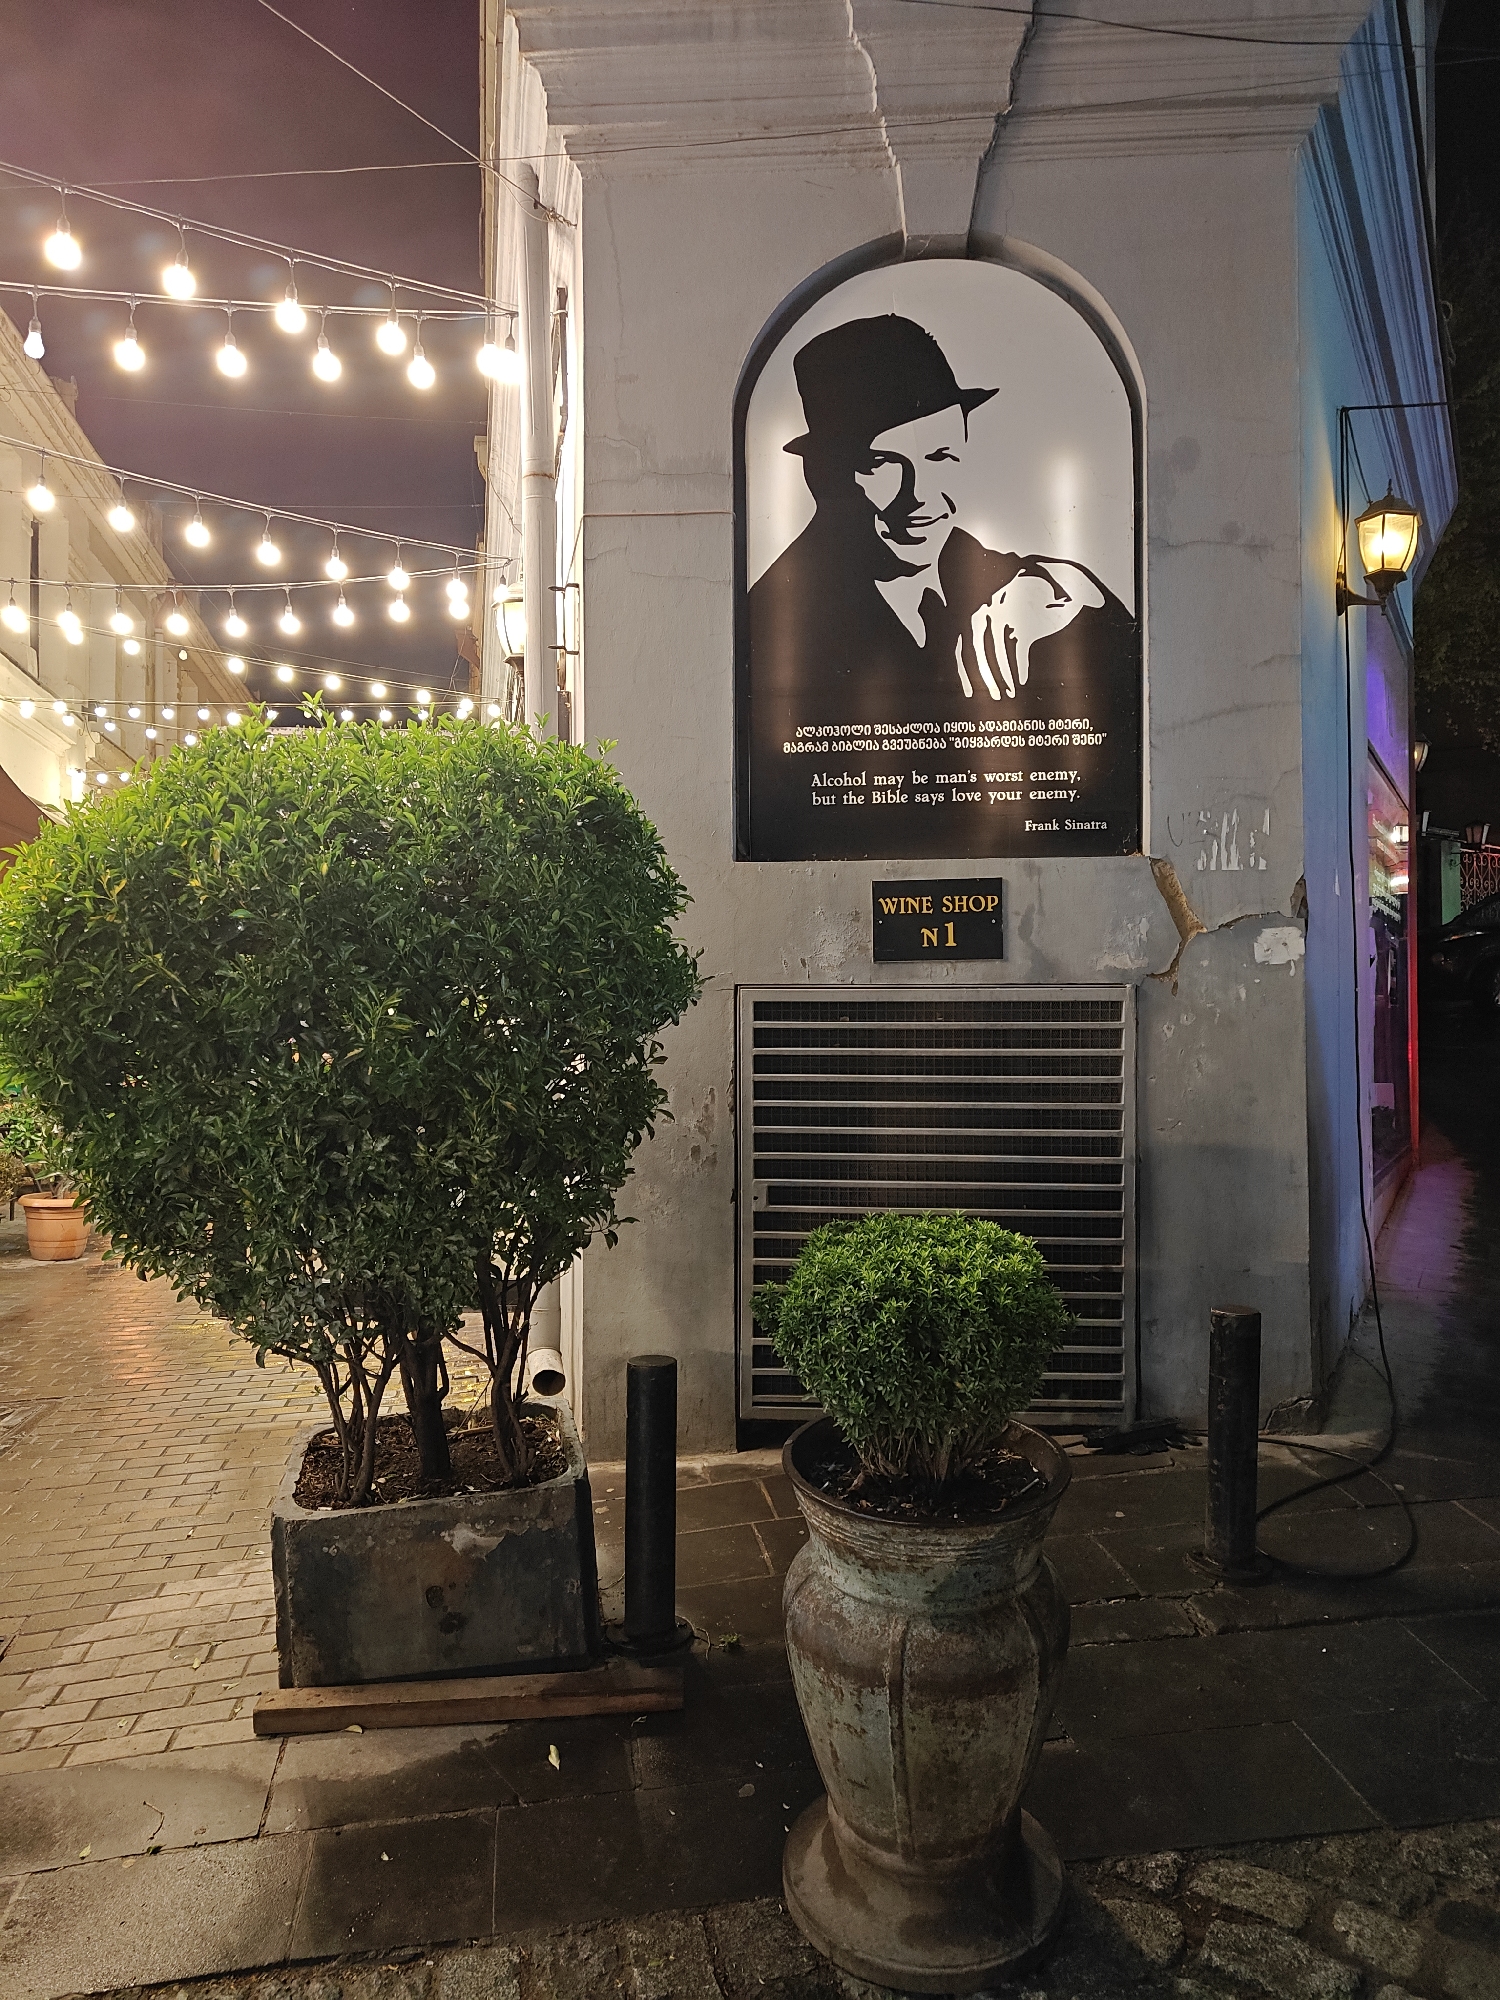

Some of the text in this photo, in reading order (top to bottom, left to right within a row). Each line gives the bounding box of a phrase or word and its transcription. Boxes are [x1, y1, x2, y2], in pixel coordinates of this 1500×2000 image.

[795, 718, 1094, 738] ალკოჰოლი შესაძლოა იყოს ადამიანის მტერი,
[783, 740, 829, 754] მაგრამ
[831, 739, 880, 752] ბიბლია
[881, 737, 947, 751] გვეუბნება
[1028, 734, 1070, 747] მტერი
[1071, 733, 1107, 746] შენი"
[811, 770, 1081, 788] Alcohol may be man's worst enemy,
[812, 788, 1081, 806] but the Bible says love your enemy.
[1024, 819, 1108, 831] Frank Sinatra
[878, 895, 999, 914] WINE SHOP
